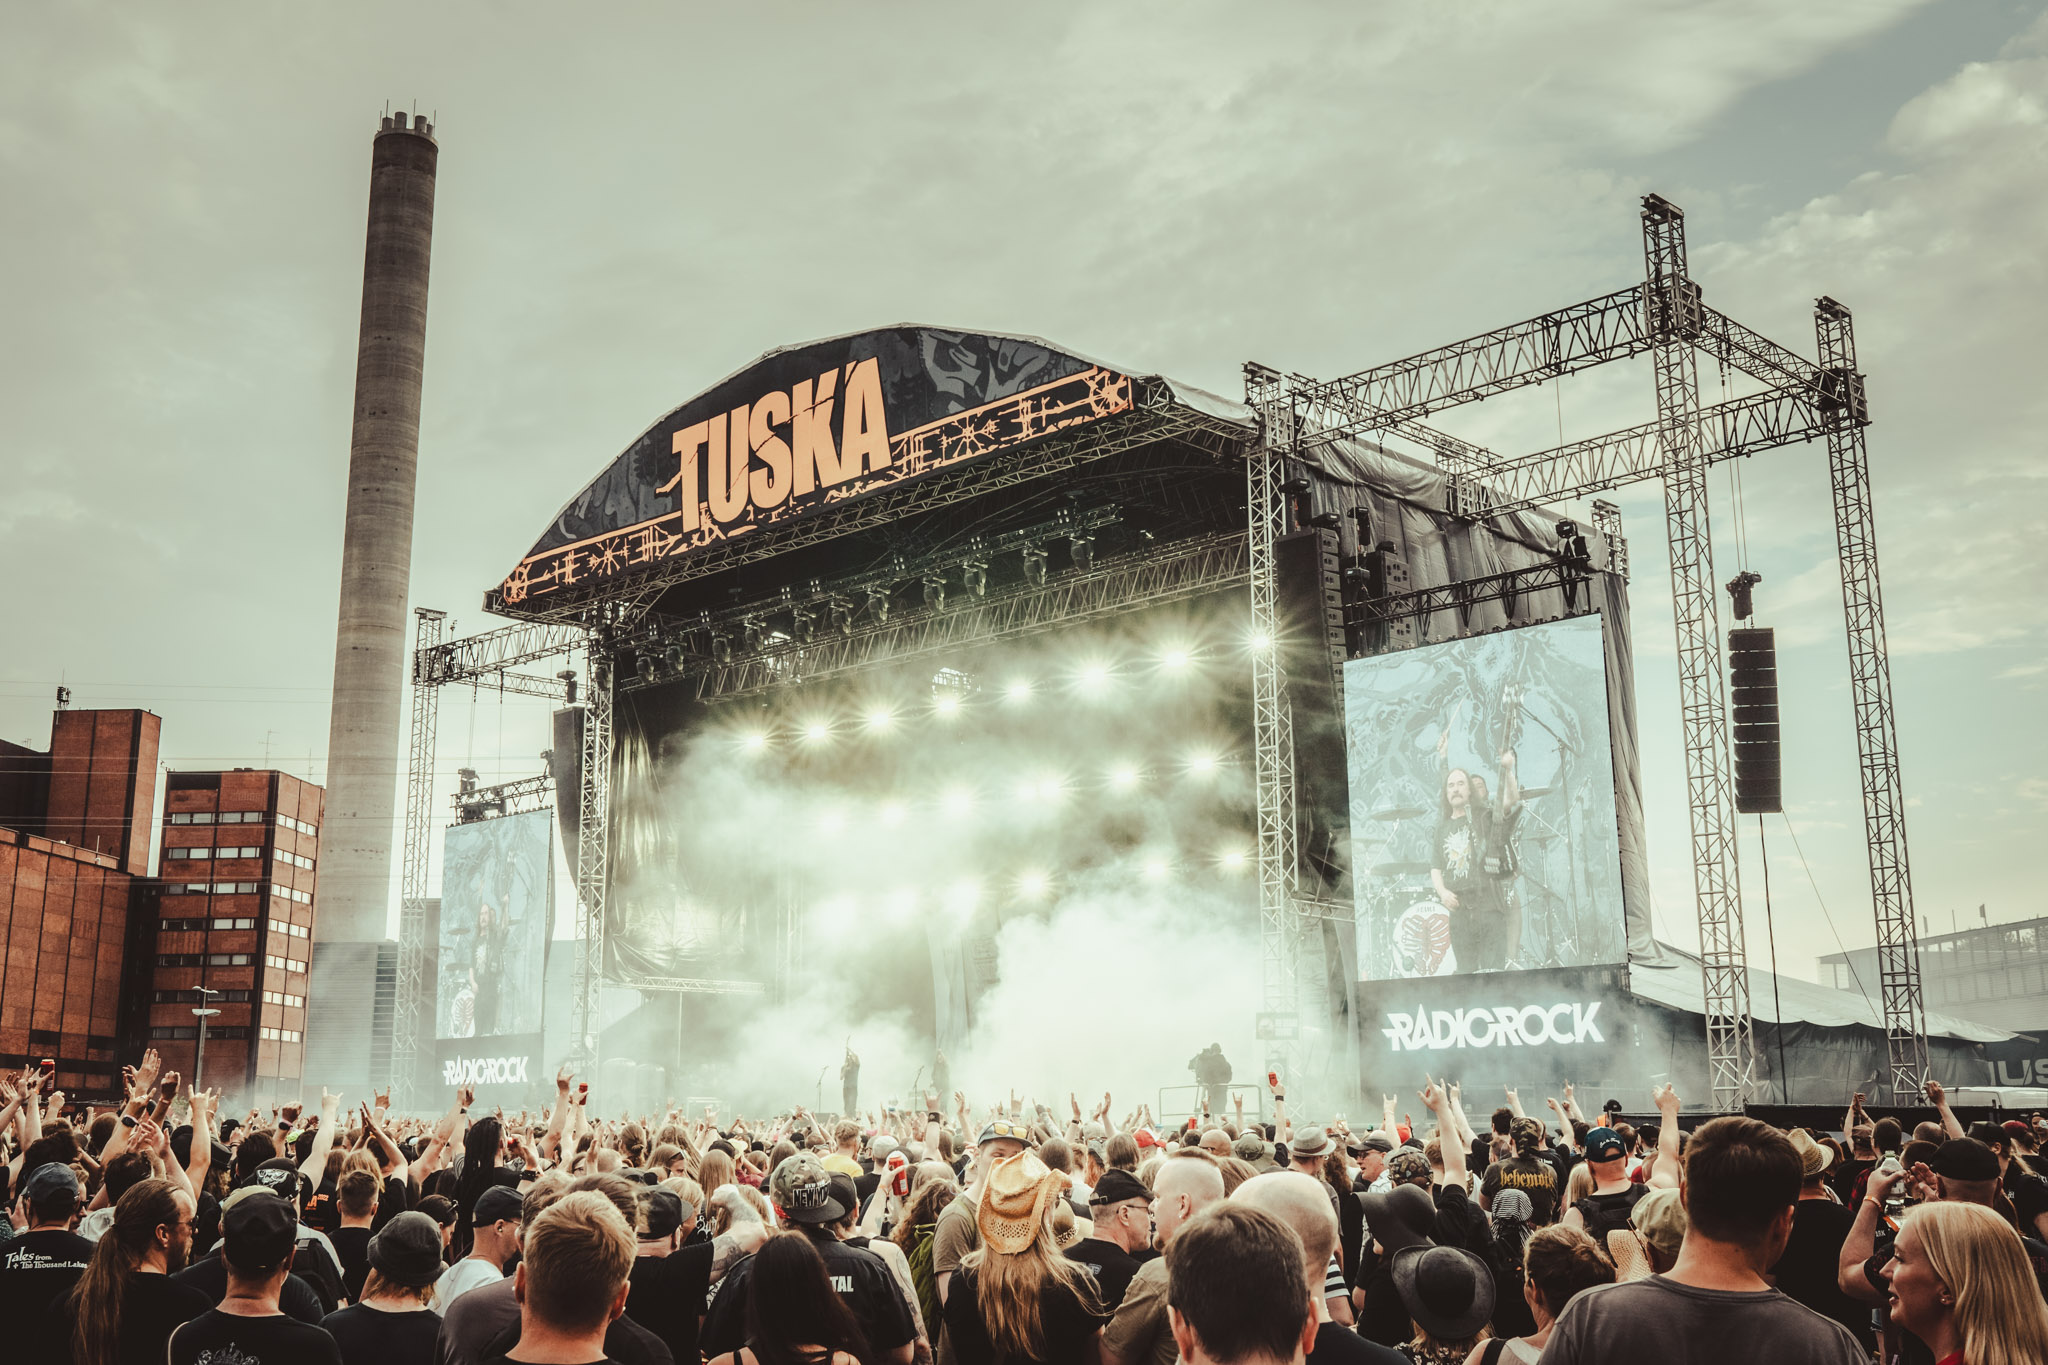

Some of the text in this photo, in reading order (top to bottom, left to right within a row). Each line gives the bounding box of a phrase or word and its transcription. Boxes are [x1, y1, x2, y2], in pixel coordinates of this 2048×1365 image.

[664, 356, 893, 534] TUSKA
[5, 1246, 35, 1269] Tales
[68, 1261, 88, 1269] Lakes
[829, 1275, 854, 1293] TAL
